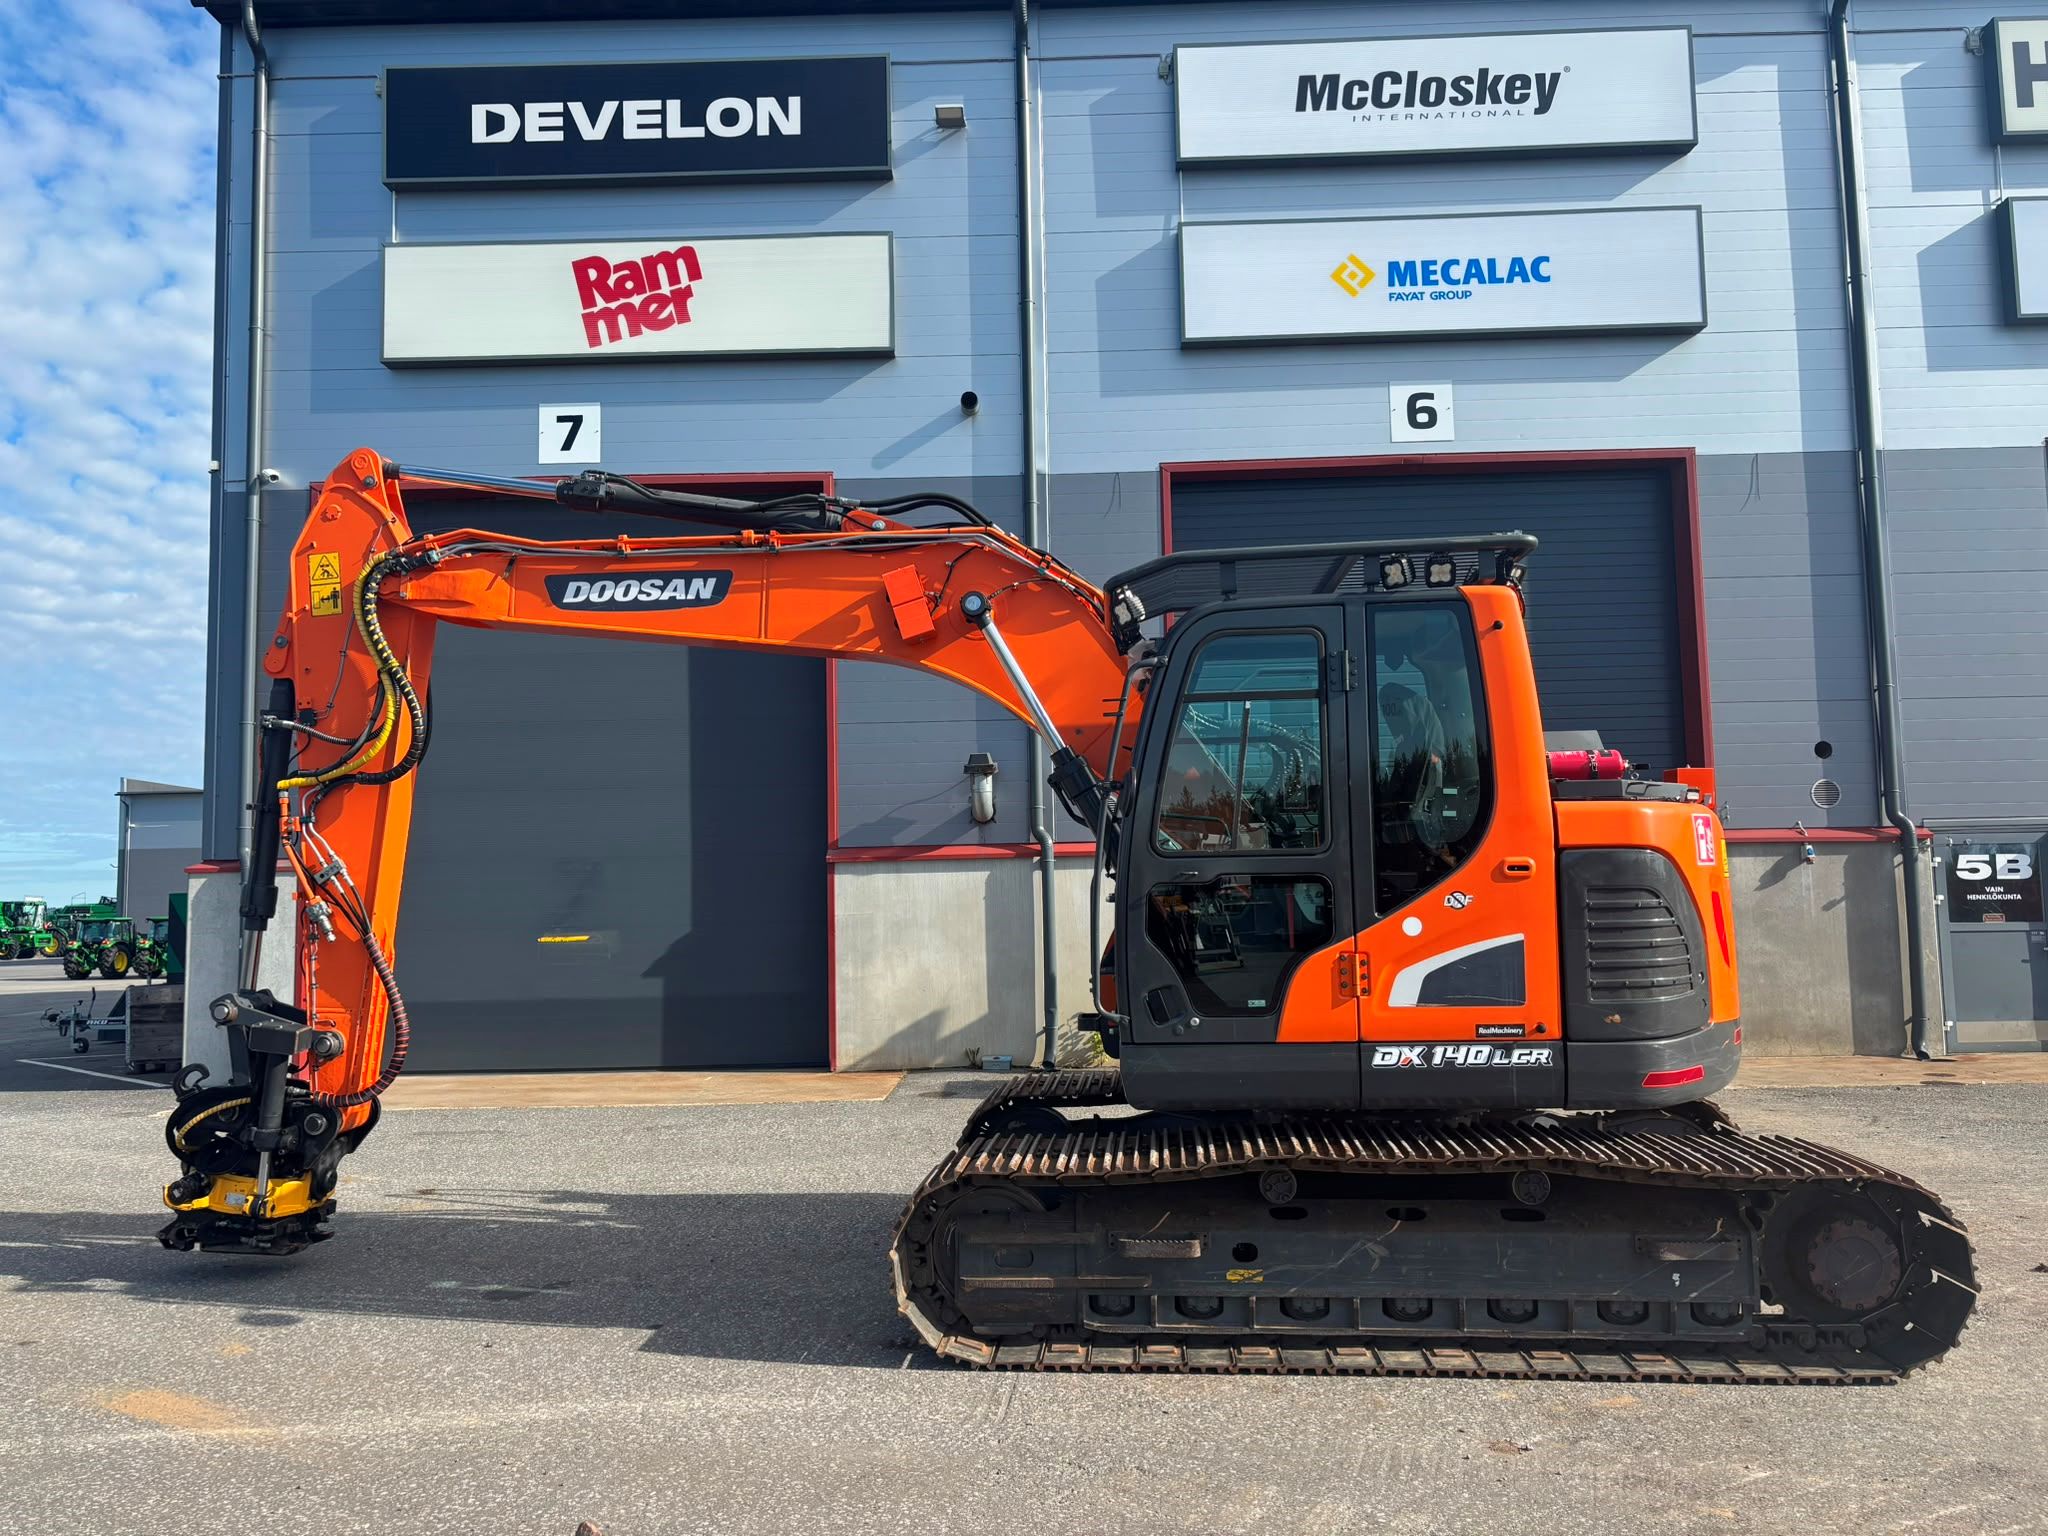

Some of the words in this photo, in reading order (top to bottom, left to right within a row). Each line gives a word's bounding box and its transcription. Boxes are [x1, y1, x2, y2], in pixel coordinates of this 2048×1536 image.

[1295, 67, 1561, 115] McCloskey
[471, 96, 801, 143] DEVELON
[1352, 109, 1525, 122] INTERNATIONAL
[571, 245, 703, 310] Ram
[1388, 256, 1551, 287] MECALAC
[1388, 291, 1425, 301] FAYAT
[1430, 290, 1472, 300] GROUP
[581, 284, 694, 348] mer
[1406, 392, 1438, 430] 6
[556, 414, 584, 452] 7
[563, 577, 717, 603] DOOSAN
[1955, 853, 2033, 880] 5B
[1966, 892, 2022, 901] HENKILÖKUNTA
[1478, 1025, 1523, 1035] RealMachinery
[1372, 1045, 1428, 1068] DX
